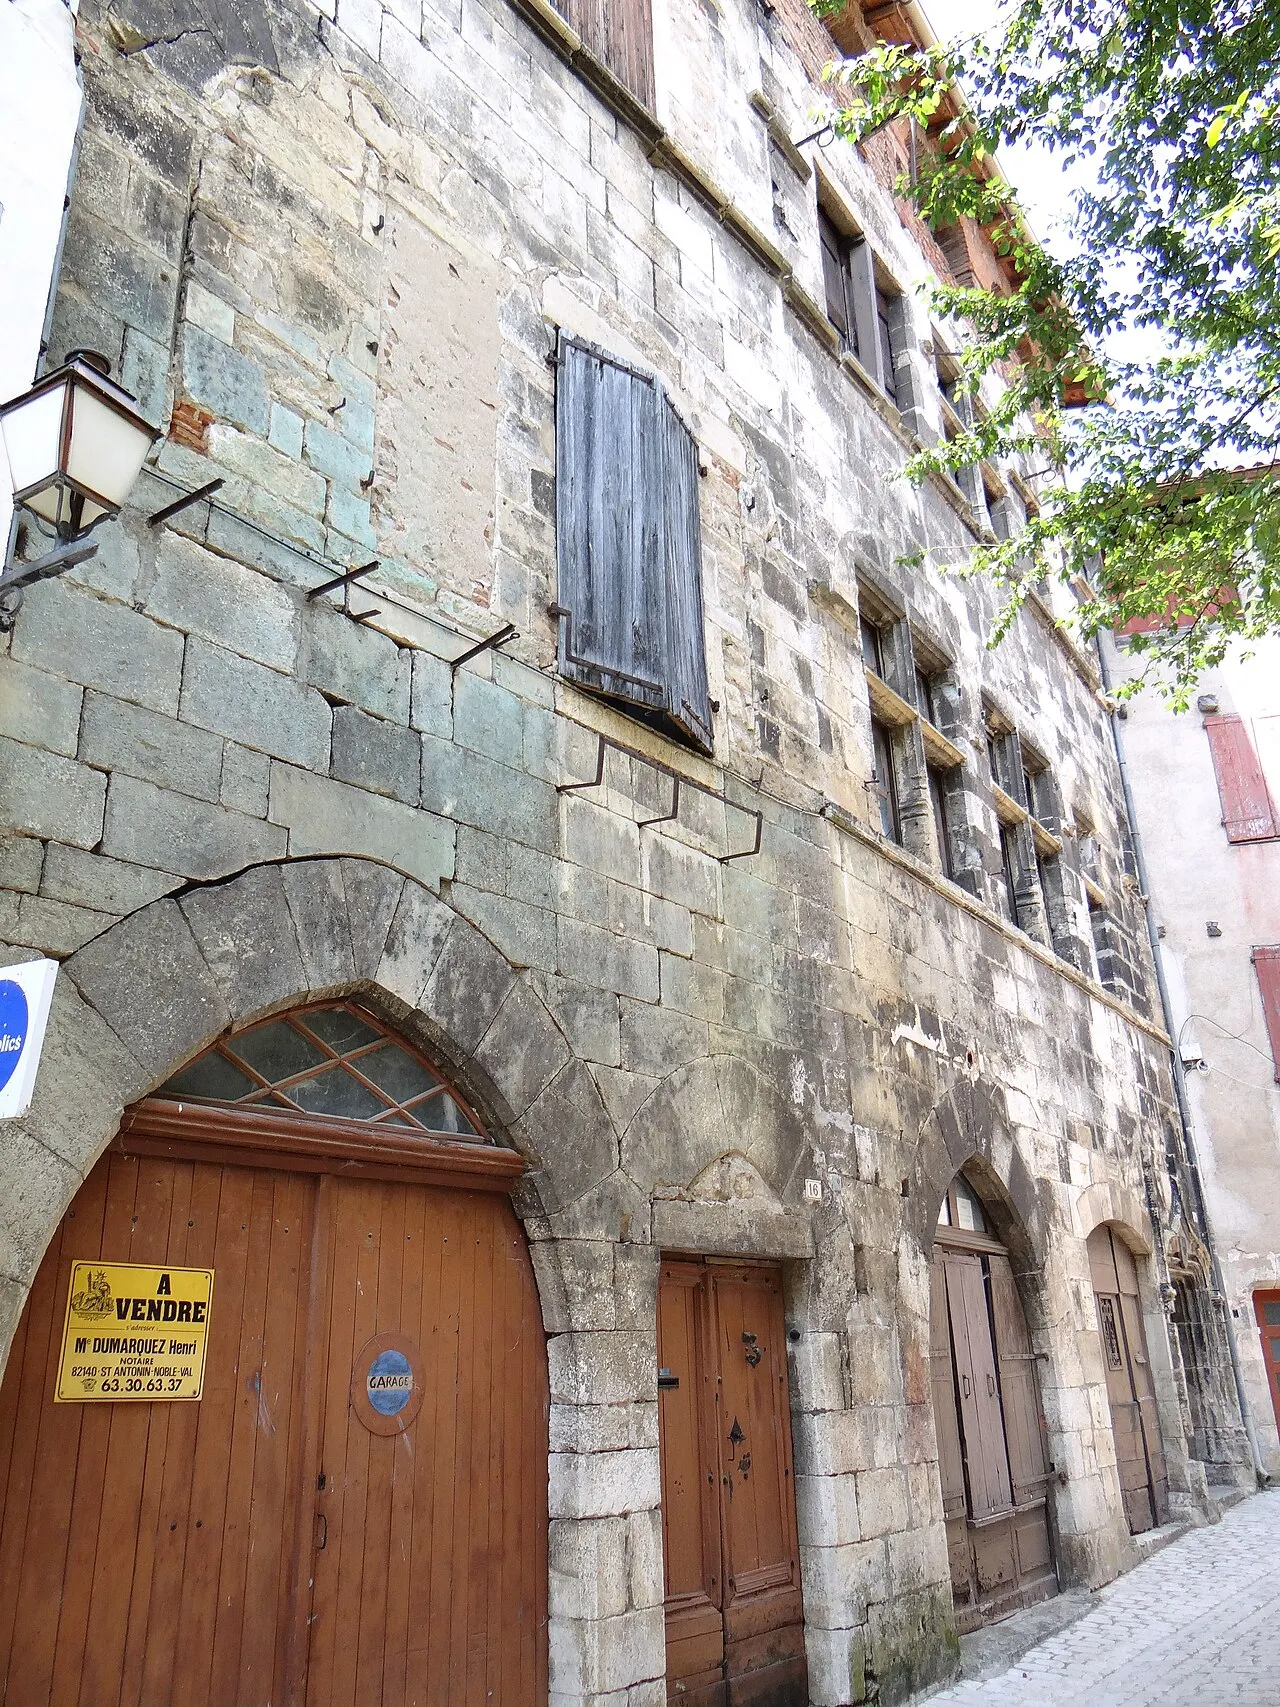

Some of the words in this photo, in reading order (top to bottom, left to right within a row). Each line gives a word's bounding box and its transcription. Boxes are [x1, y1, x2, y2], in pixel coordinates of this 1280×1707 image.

[809, 1183, 819, 1196] 16
[156, 1274, 171, 1295] A
[115, 1298, 206, 1322] VENDRE
[92, 1337, 166, 1356] DUMARQUEZ
[168, 1340, 197, 1355] Henri
[119, 1357, 154, 1365] NOTAIRE
[101, 1379, 182, 1392] 63.30.63.37
[370, 1376, 409, 1388] GARAGE
